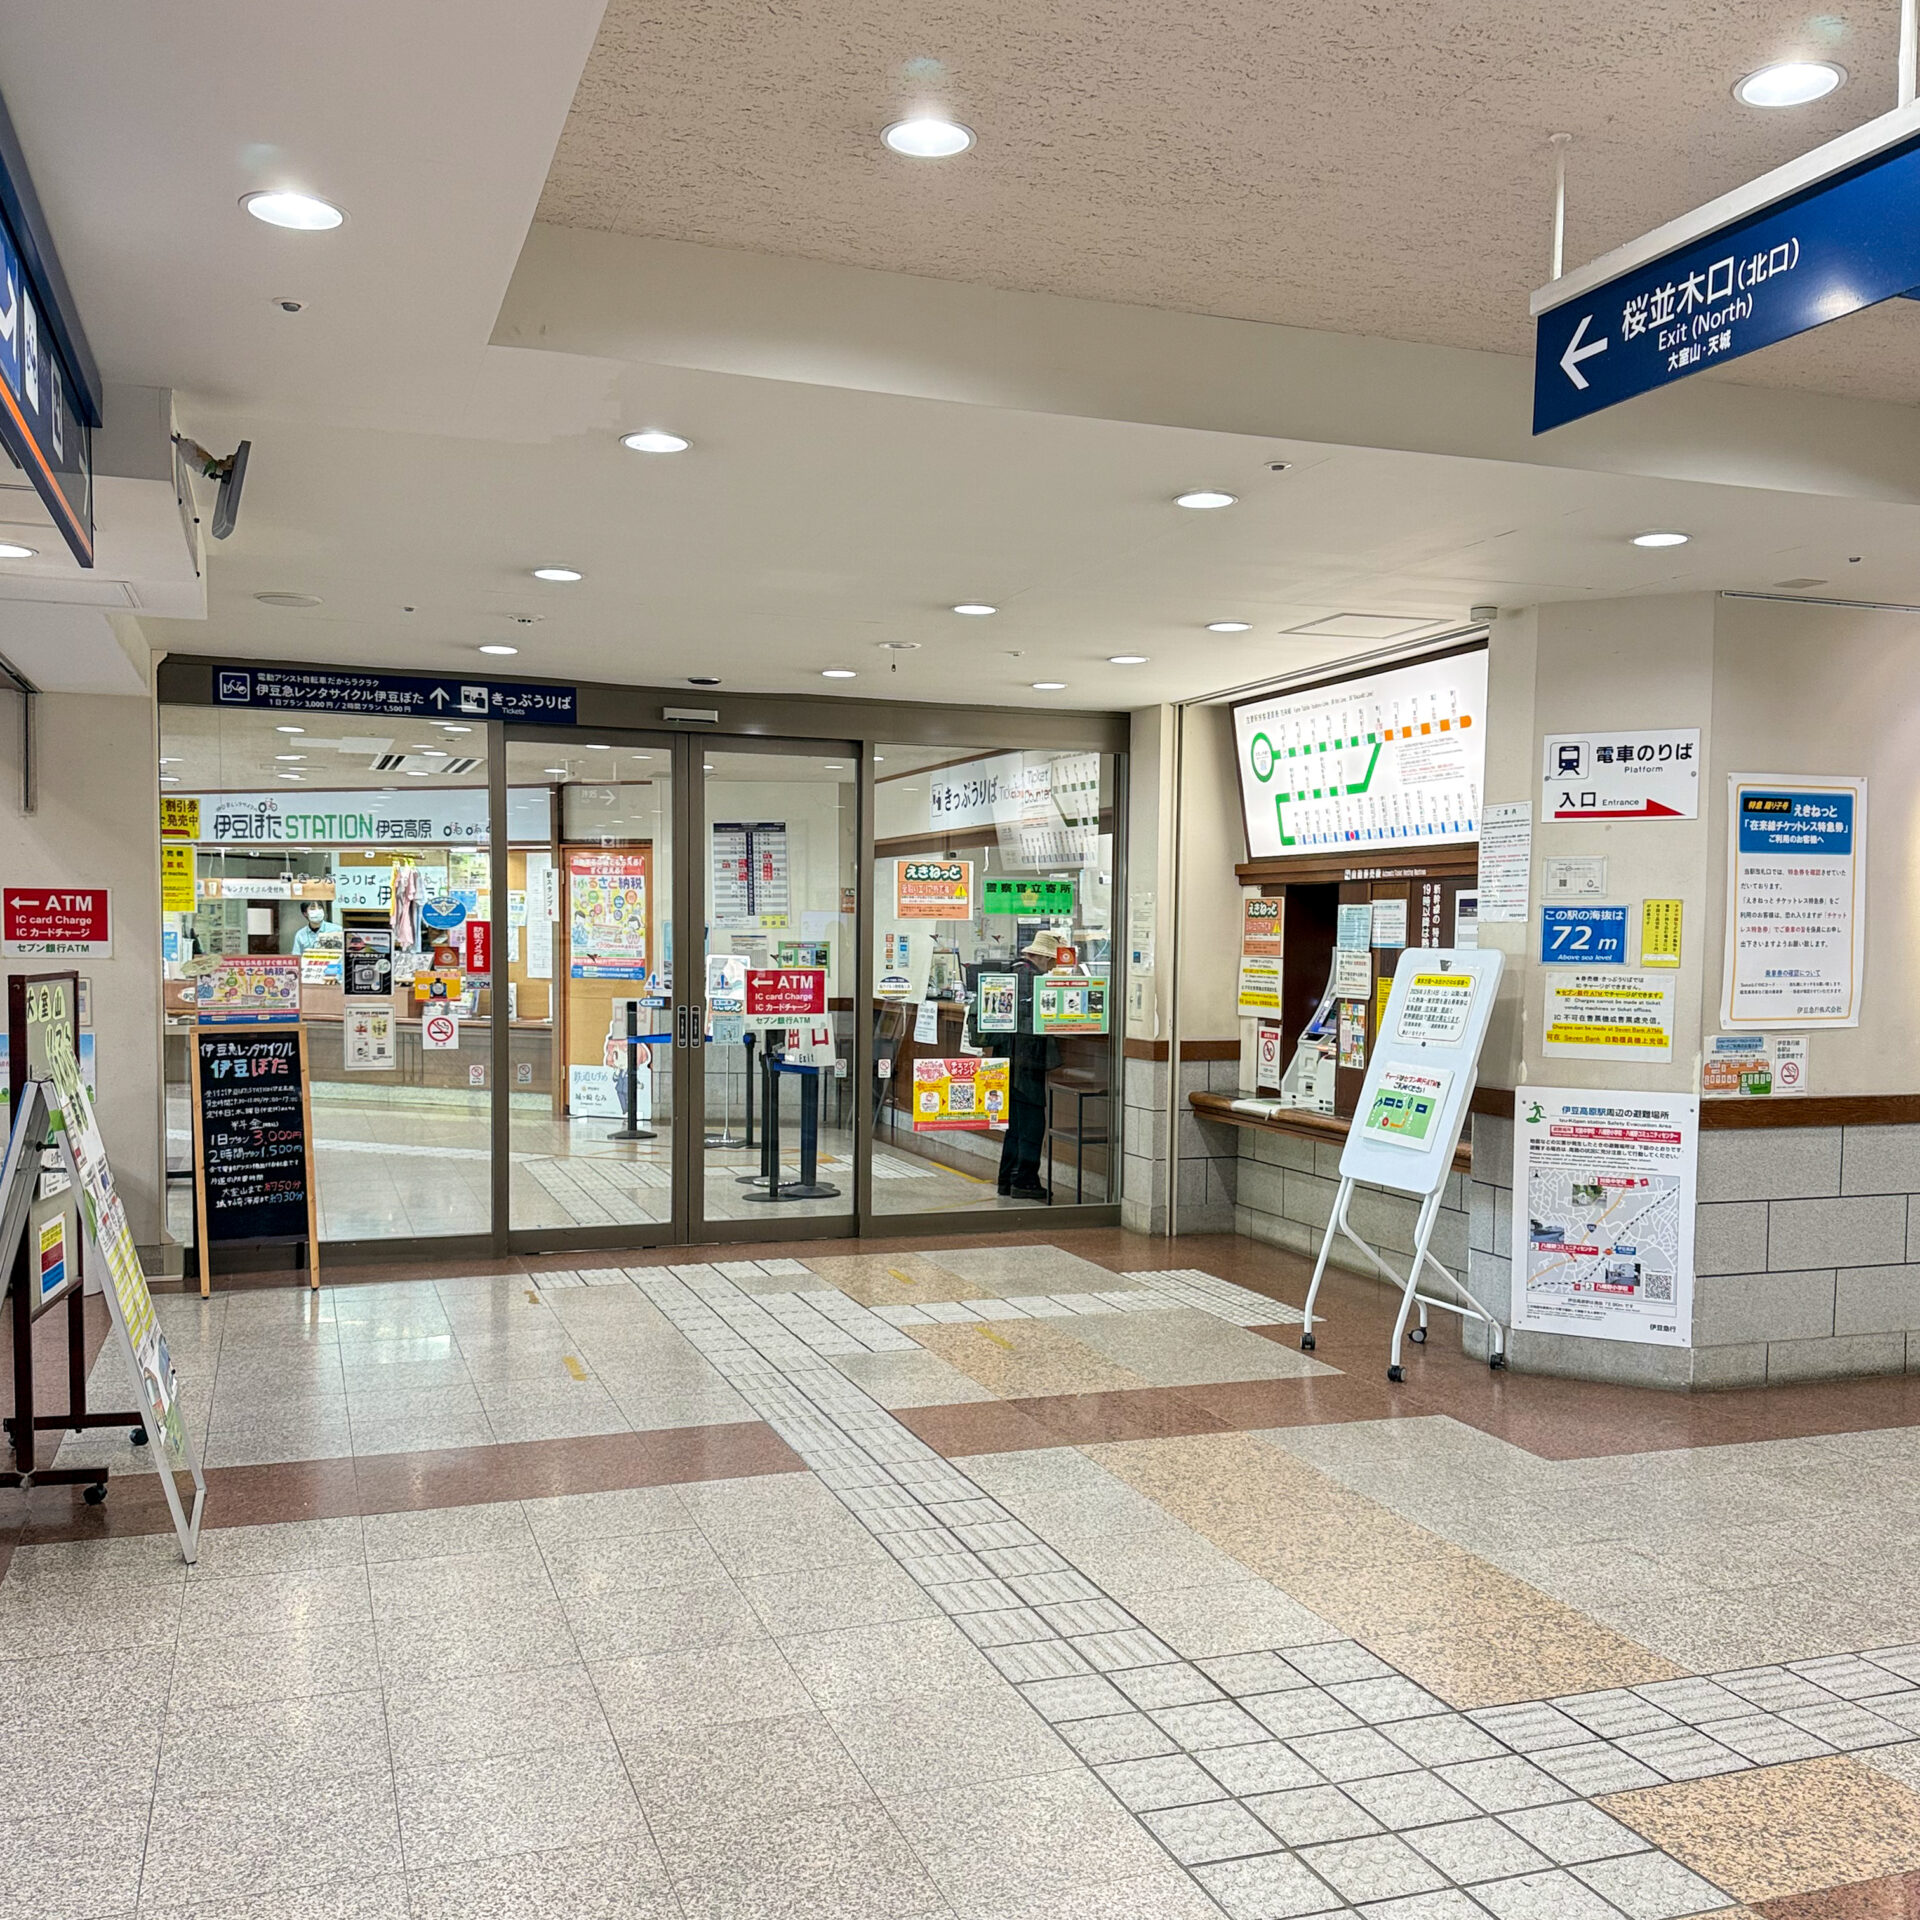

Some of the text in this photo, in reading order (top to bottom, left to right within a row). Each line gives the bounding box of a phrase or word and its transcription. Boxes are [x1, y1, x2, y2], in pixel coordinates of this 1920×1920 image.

[1622, 236, 1800, 341] 桜並木口(北口)
[1658, 293, 1753, 351] Exit (North)
[1667, 329, 1732, 372] 大室山・天城
[491, 692, 572, 710] きっぷうりば
[502, 707, 525, 716] Tickets
[1596, 742, 1694, 766] 電車のりば
[1624, 766, 1663, 775] Platform
[944, 774, 998, 812] きっぷうりば
[1559, 792, 1640, 808] 入口 Entrance
[1793, 804, 1838, 818] えきねっと
[285, 814, 373, 839] STATION
[376, 819, 432, 839] 伊豆高原
[905, 864, 962, 880] えきねっと
[44, 894, 93, 912] ATM
[1247, 901, 1278, 918] えきねっと
[15, 915, 92, 927] IC card Charge
[1544, 909, 1624, 922] この駅の海抜は
[30, 928, 90, 938] カードチャージ
[1549, 926, 1618, 950] 72 m
[17, 943, 89, 953] セブン銀行ATM
[776, 975, 814, 989] ATM
[754, 992, 813, 1002] IC card Charge
[766, 1003, 811, 1012] カードチャージ
[755, 1016, 811, 1025] セブン銀行ATM
[799, 1053, 815, 1063] Exit
[1562, 1105, 1670, 1119] 伊豆高原駅周辺の避難場所
[210, 1134, 250, 1146] 1日プラン
